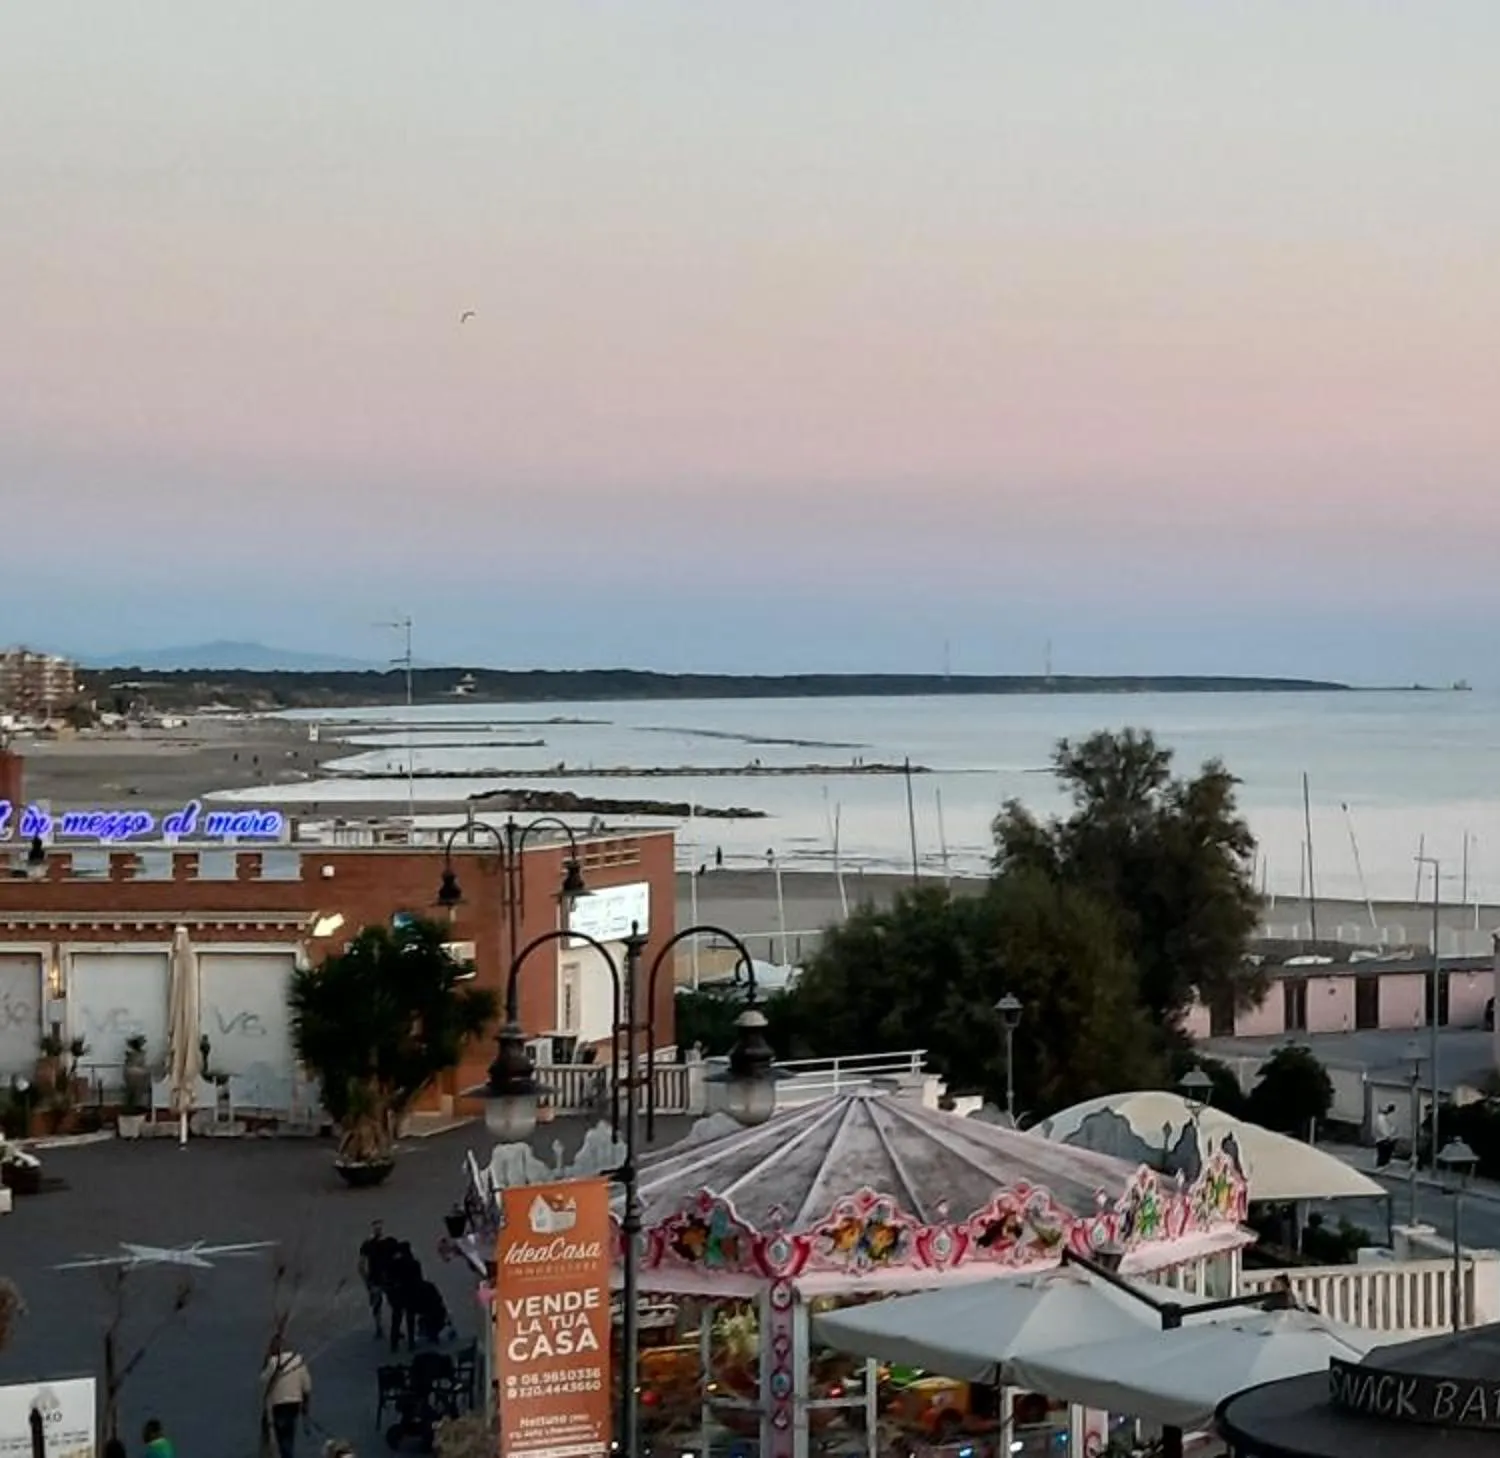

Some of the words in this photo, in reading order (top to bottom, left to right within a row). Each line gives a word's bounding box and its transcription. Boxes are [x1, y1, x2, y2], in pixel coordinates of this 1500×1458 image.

[61, 811, 154, 838] mezzo
[163, 799, 200, 836] al
[205, 811, 280, 836] mare
[503, 1236, 601, 1265] IdeaCasa
[504, 1287, 600, 1320] VENDE
[517, 1318, 542, 1335] LA
[548, 1311, 589, 1330] TUA
[507, 1327, 599, 1362] CASA
[1329, 1366, 1419, 1417] SNACK
